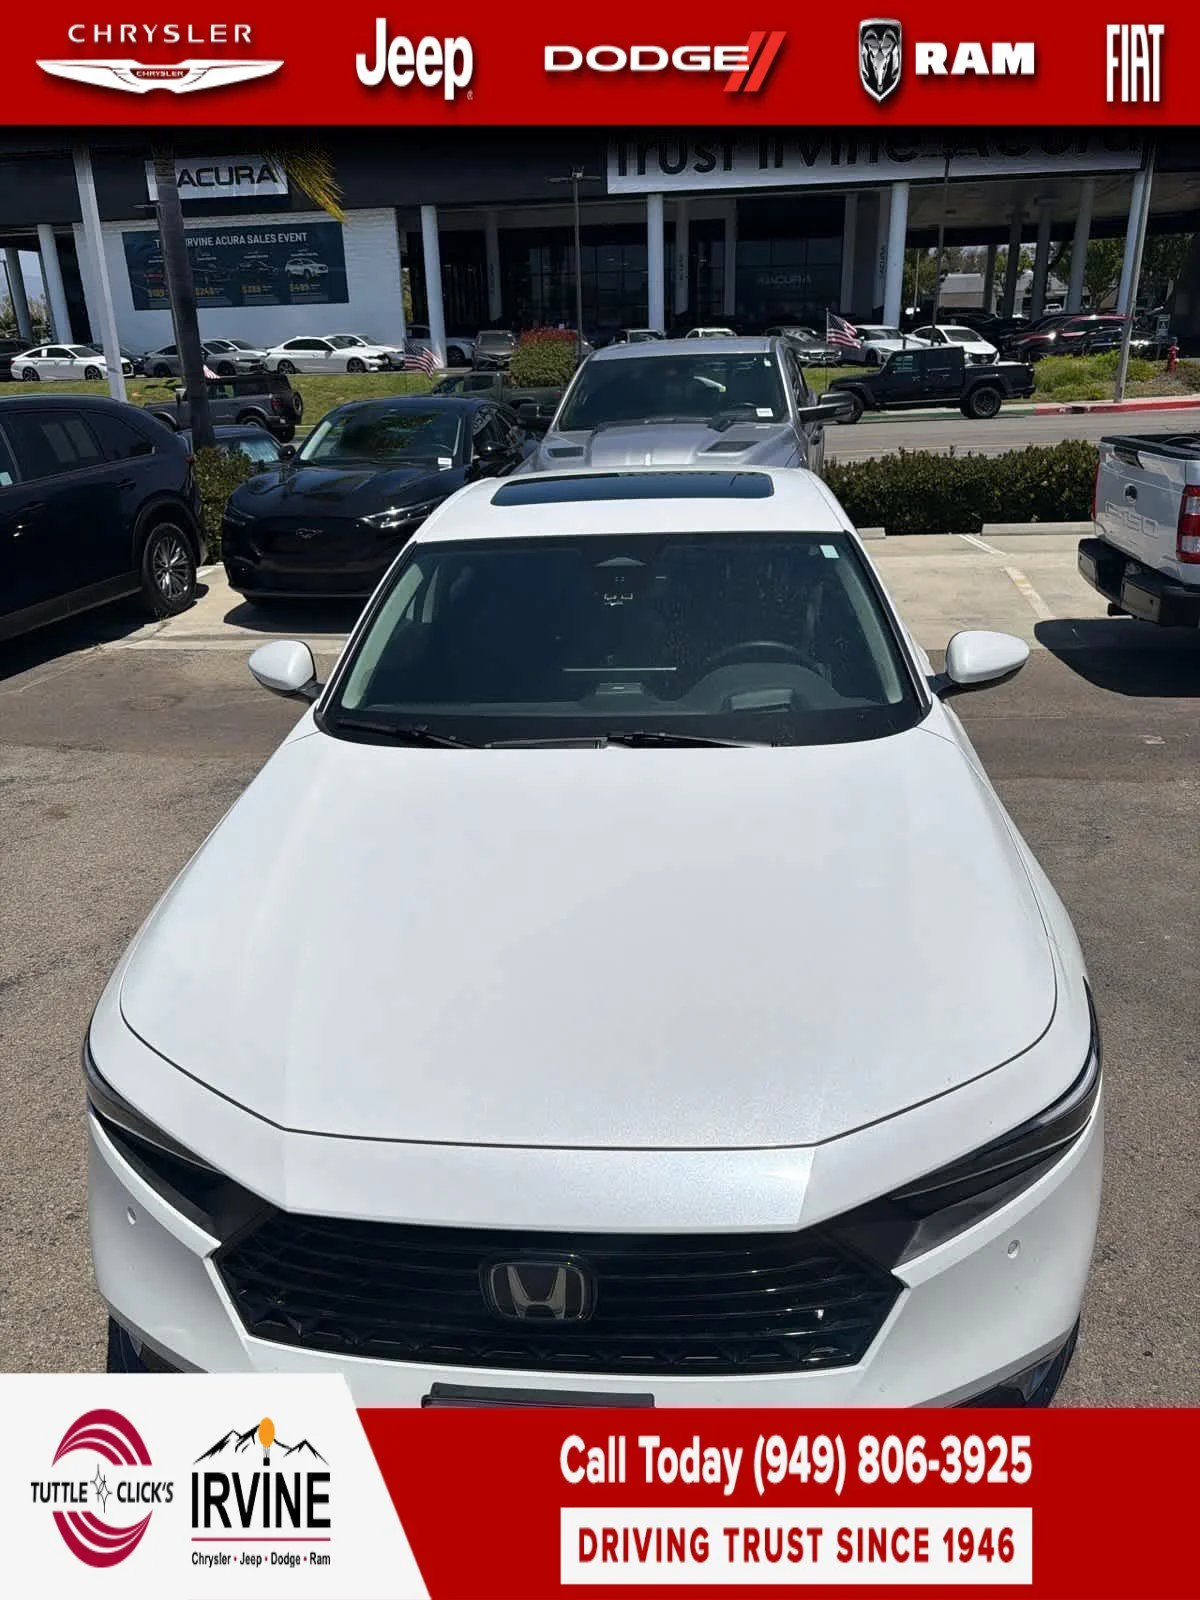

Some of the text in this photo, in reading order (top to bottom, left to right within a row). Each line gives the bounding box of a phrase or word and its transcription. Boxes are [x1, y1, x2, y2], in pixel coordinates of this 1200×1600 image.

[177, 164, 279, 188] ACURA
[215, 236, 246, 247] ACURA
[247, 233, 277, 244] SALES
[278, 232, 308, 243] EVENT
